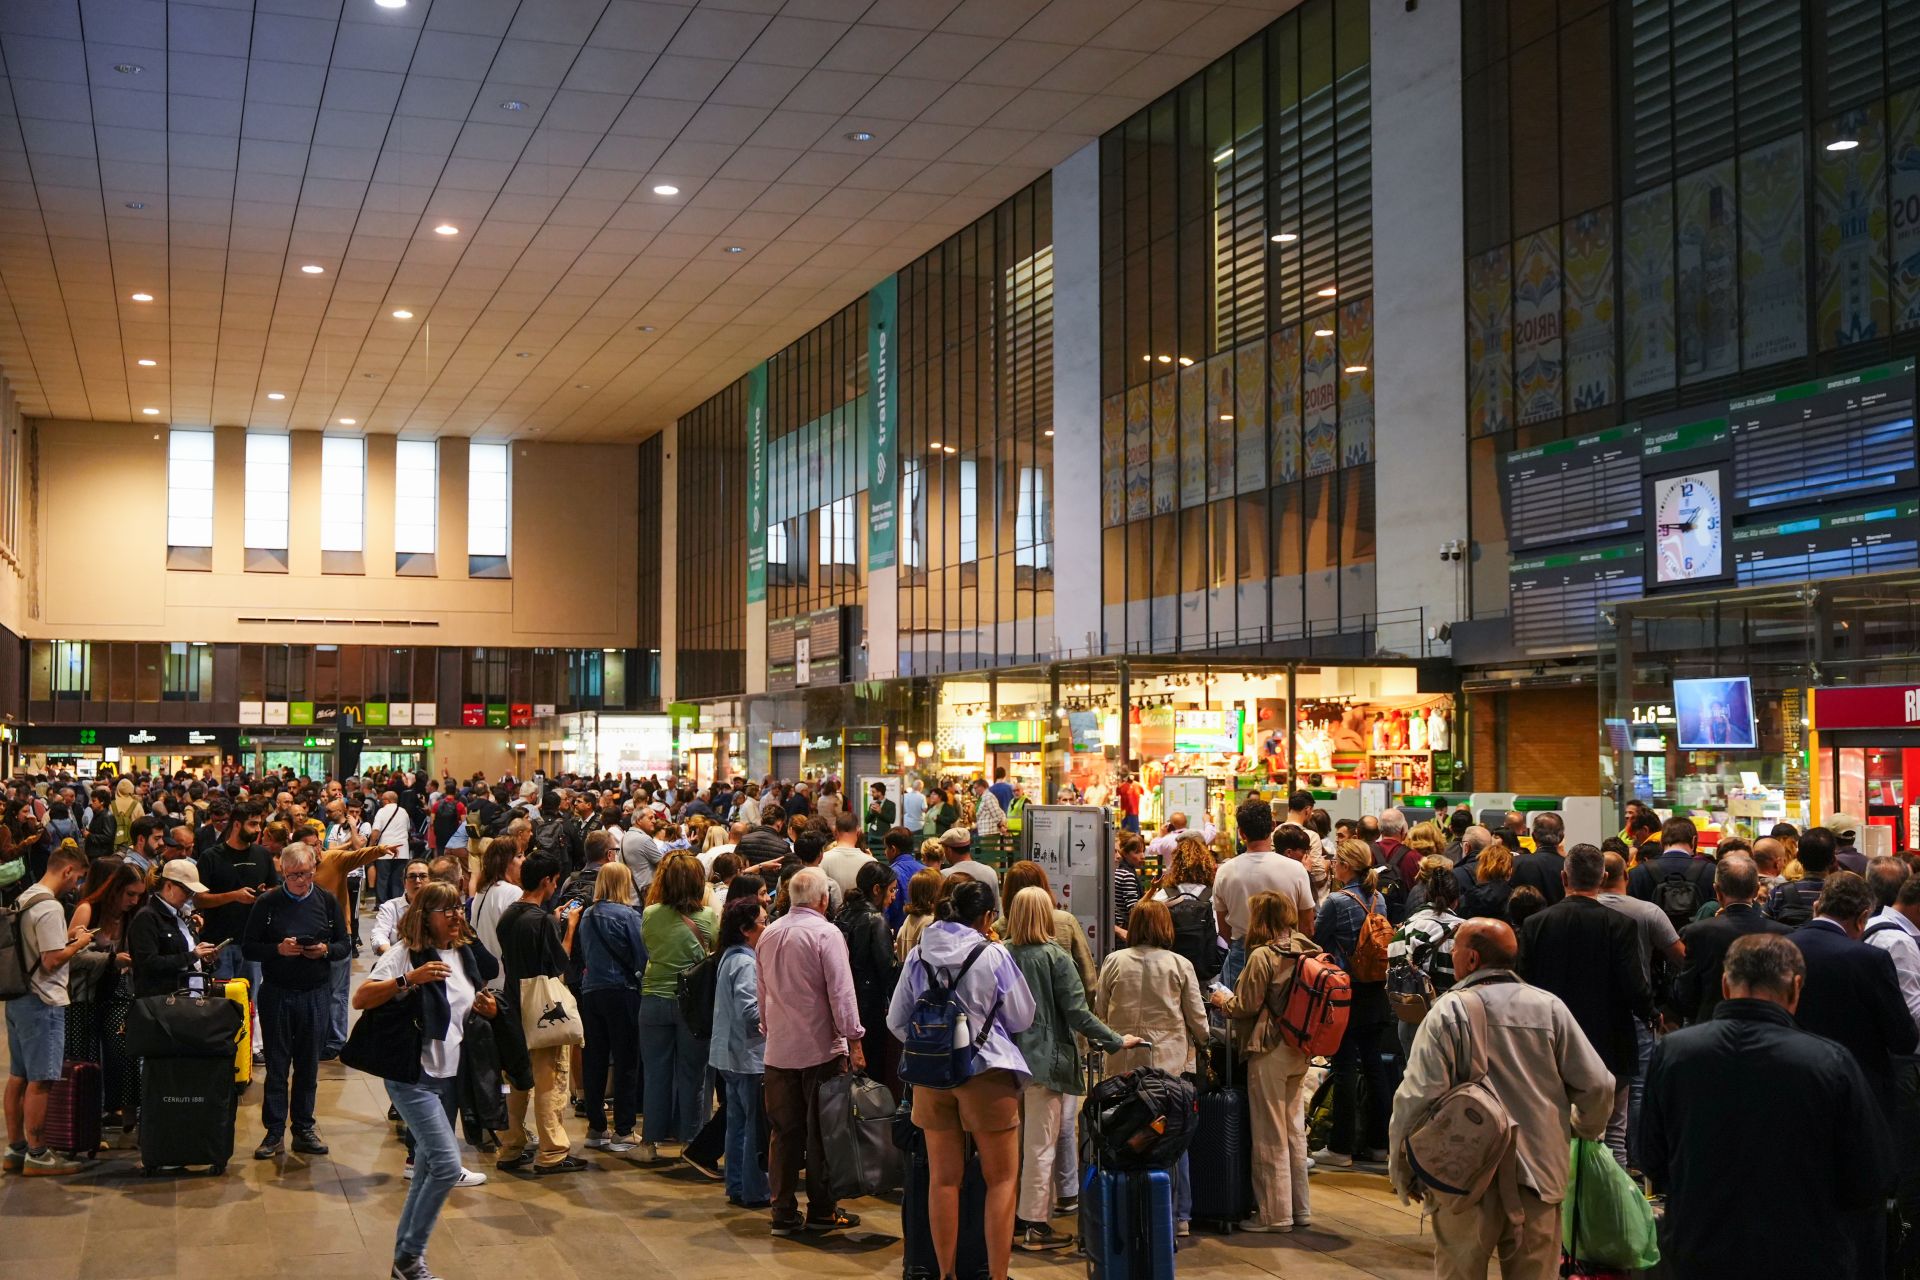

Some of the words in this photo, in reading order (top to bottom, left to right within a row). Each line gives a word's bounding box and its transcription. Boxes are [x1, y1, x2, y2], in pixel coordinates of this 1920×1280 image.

[878, 331, 888, 447] trainline
[753, 405, 762, 502] trainline
[1680, 483, 1693, 497] 12
[1707, 517, 1716, 530] 3
[1684, 557, 1693, 570] 6
